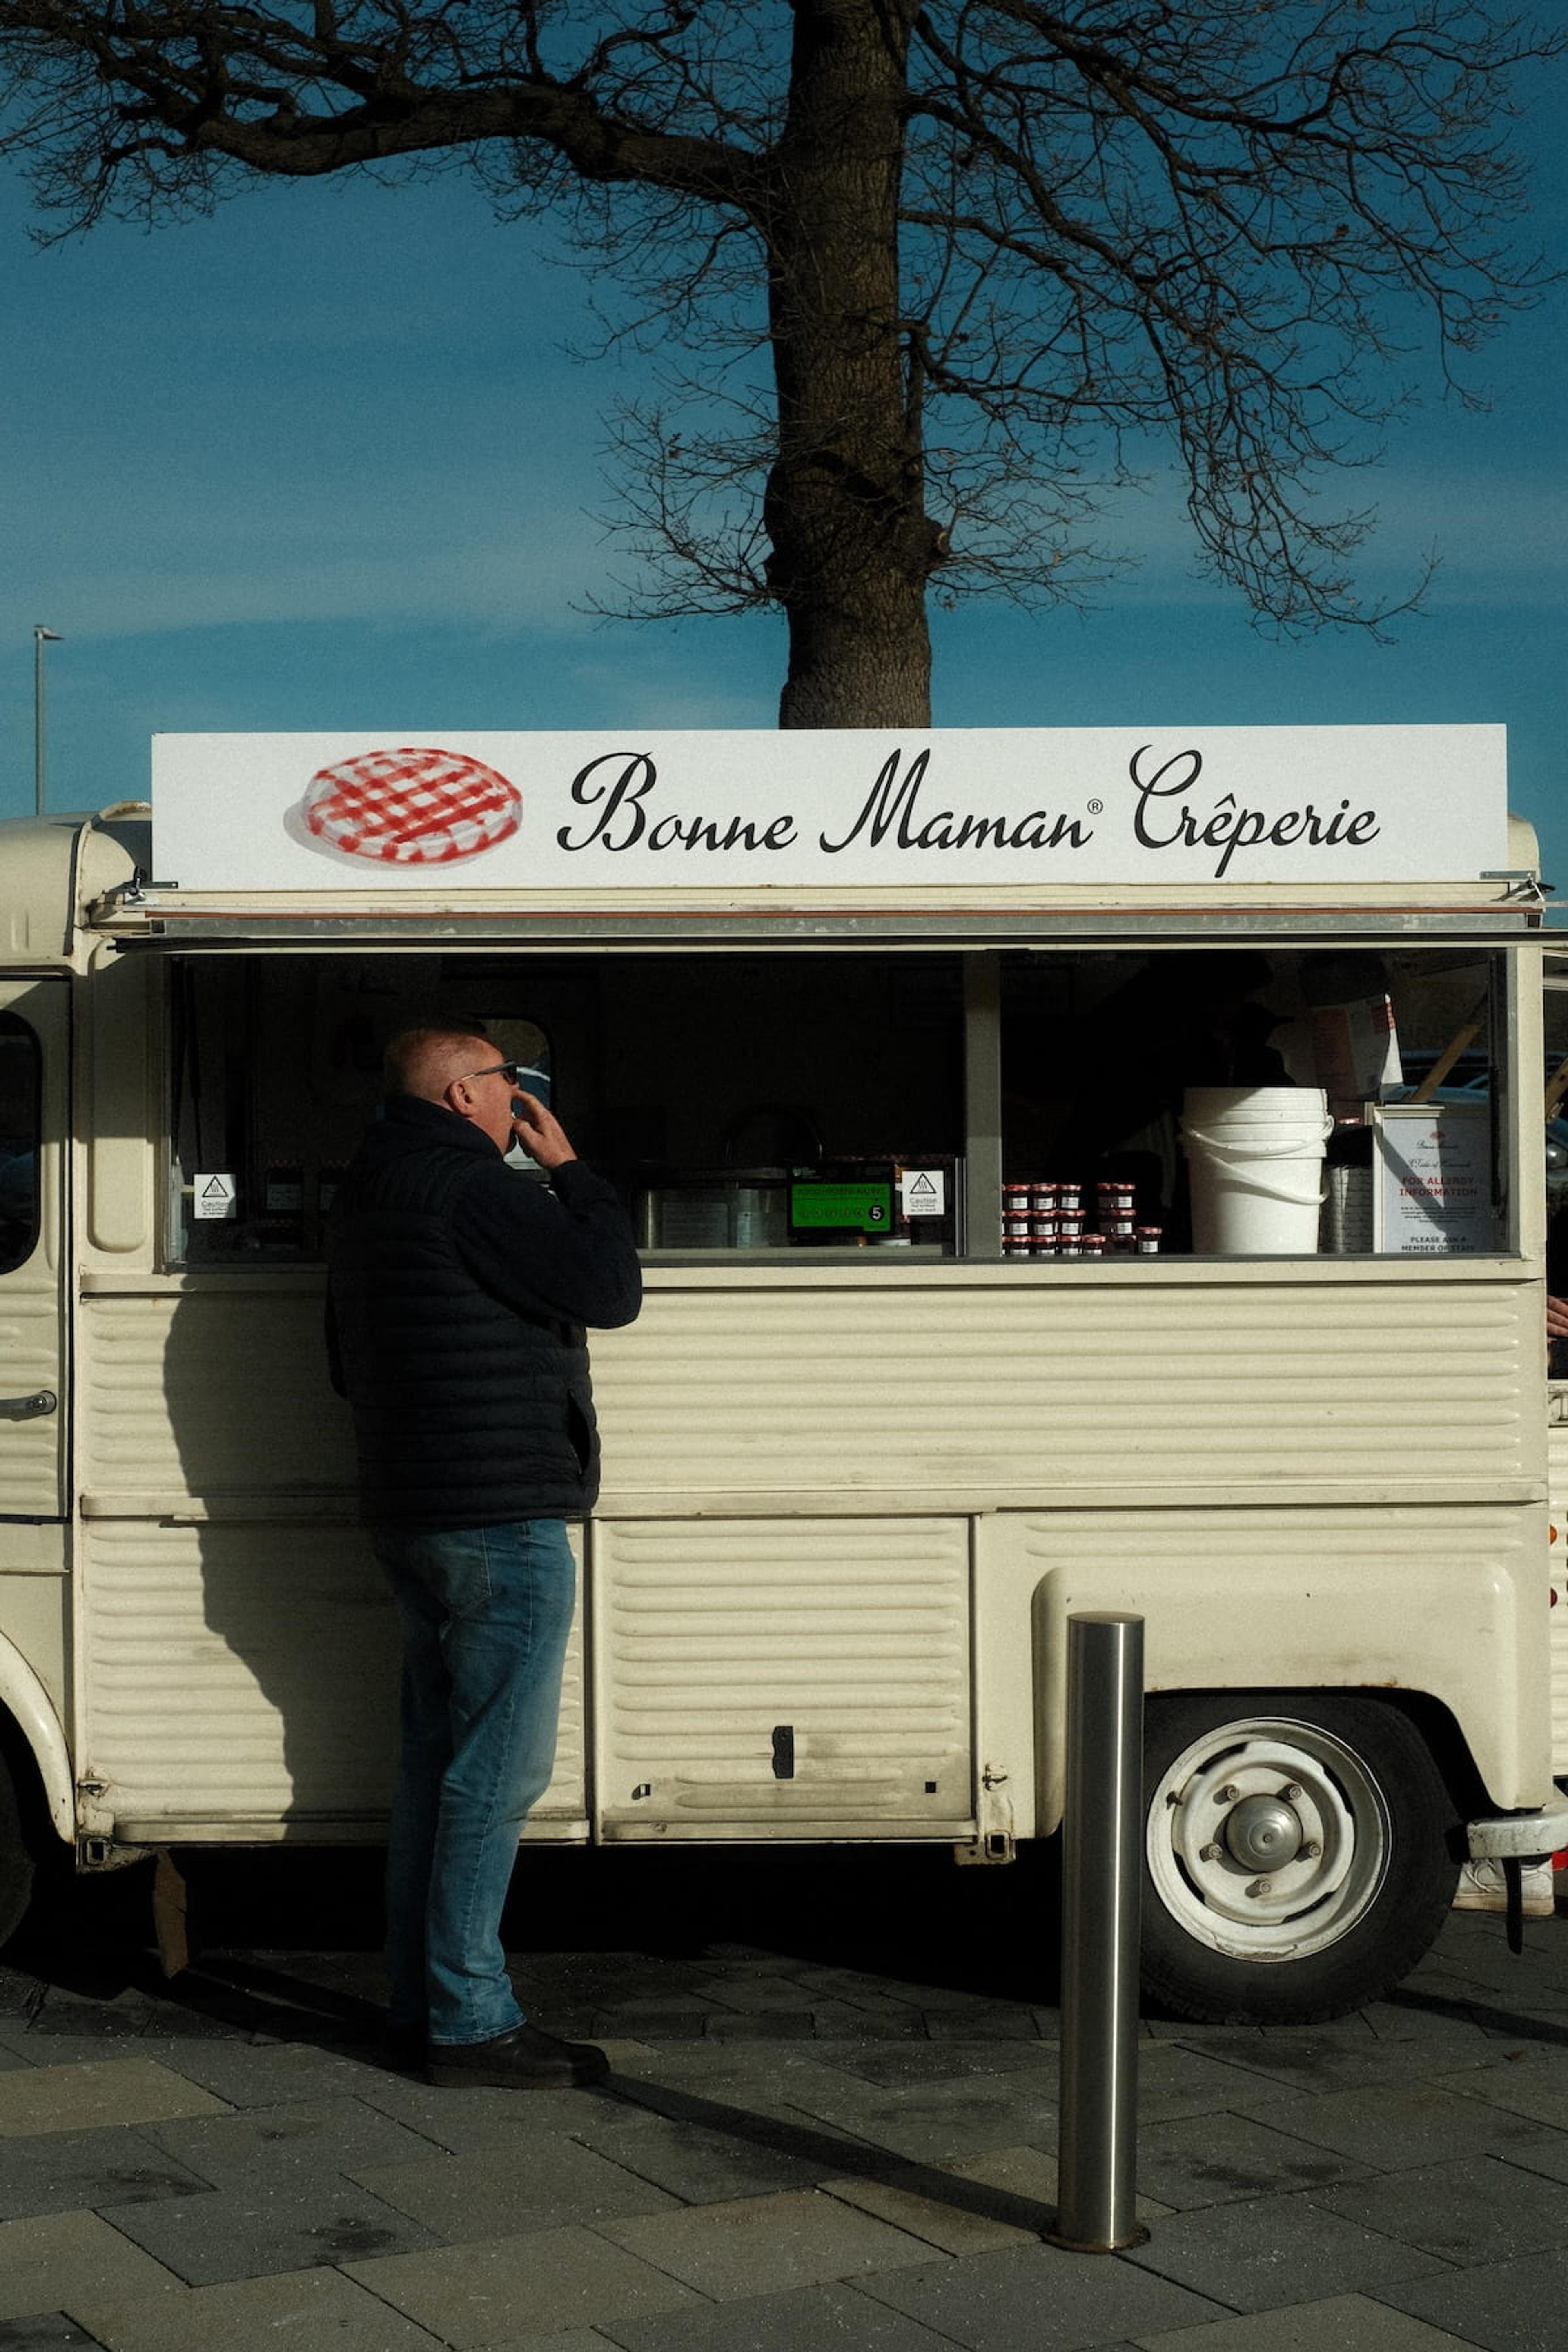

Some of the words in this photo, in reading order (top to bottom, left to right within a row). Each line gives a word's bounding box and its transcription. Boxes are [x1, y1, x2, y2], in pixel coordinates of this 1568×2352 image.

[557, 752, 798, 852] Bonne
[1129, 744, 1380, 878] Crêperie
[872, 1207, 882, 1220] 5
